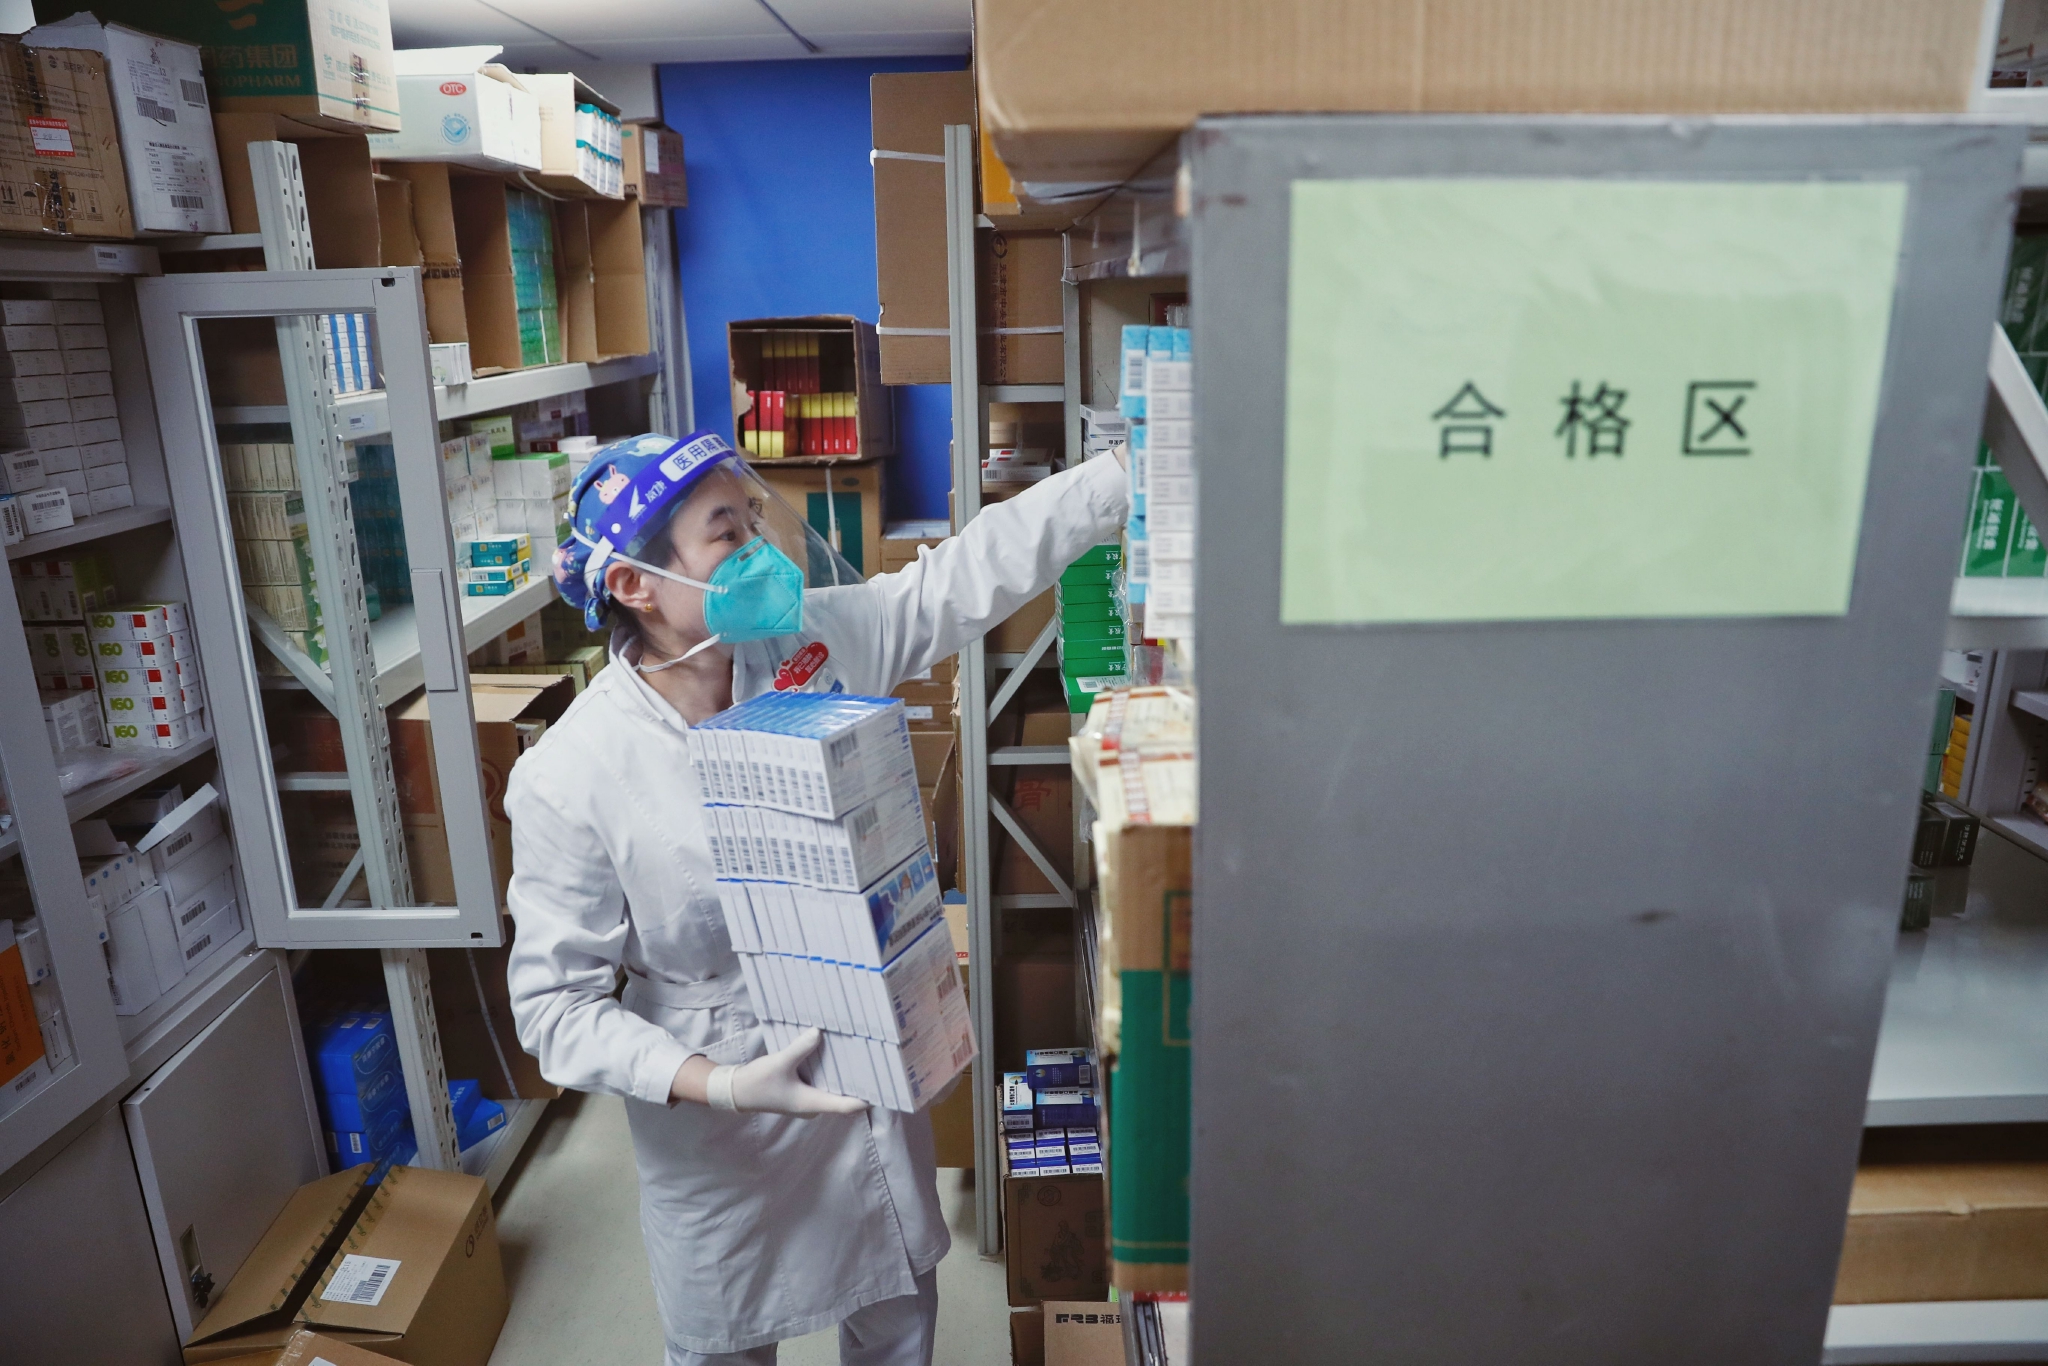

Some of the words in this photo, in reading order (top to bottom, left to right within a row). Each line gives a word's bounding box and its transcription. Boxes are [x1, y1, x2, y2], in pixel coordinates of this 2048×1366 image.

[443, 83, 465, 94] OTC
[1430, 379, 1757, 459] 合格区
[91, 614, 115, 628] 160
[98, 642, 123, 656] 160
[104, 670, 129, 684] 160
[109, 697, 135, 711] 160
[113, 725, 138, 739] 160
